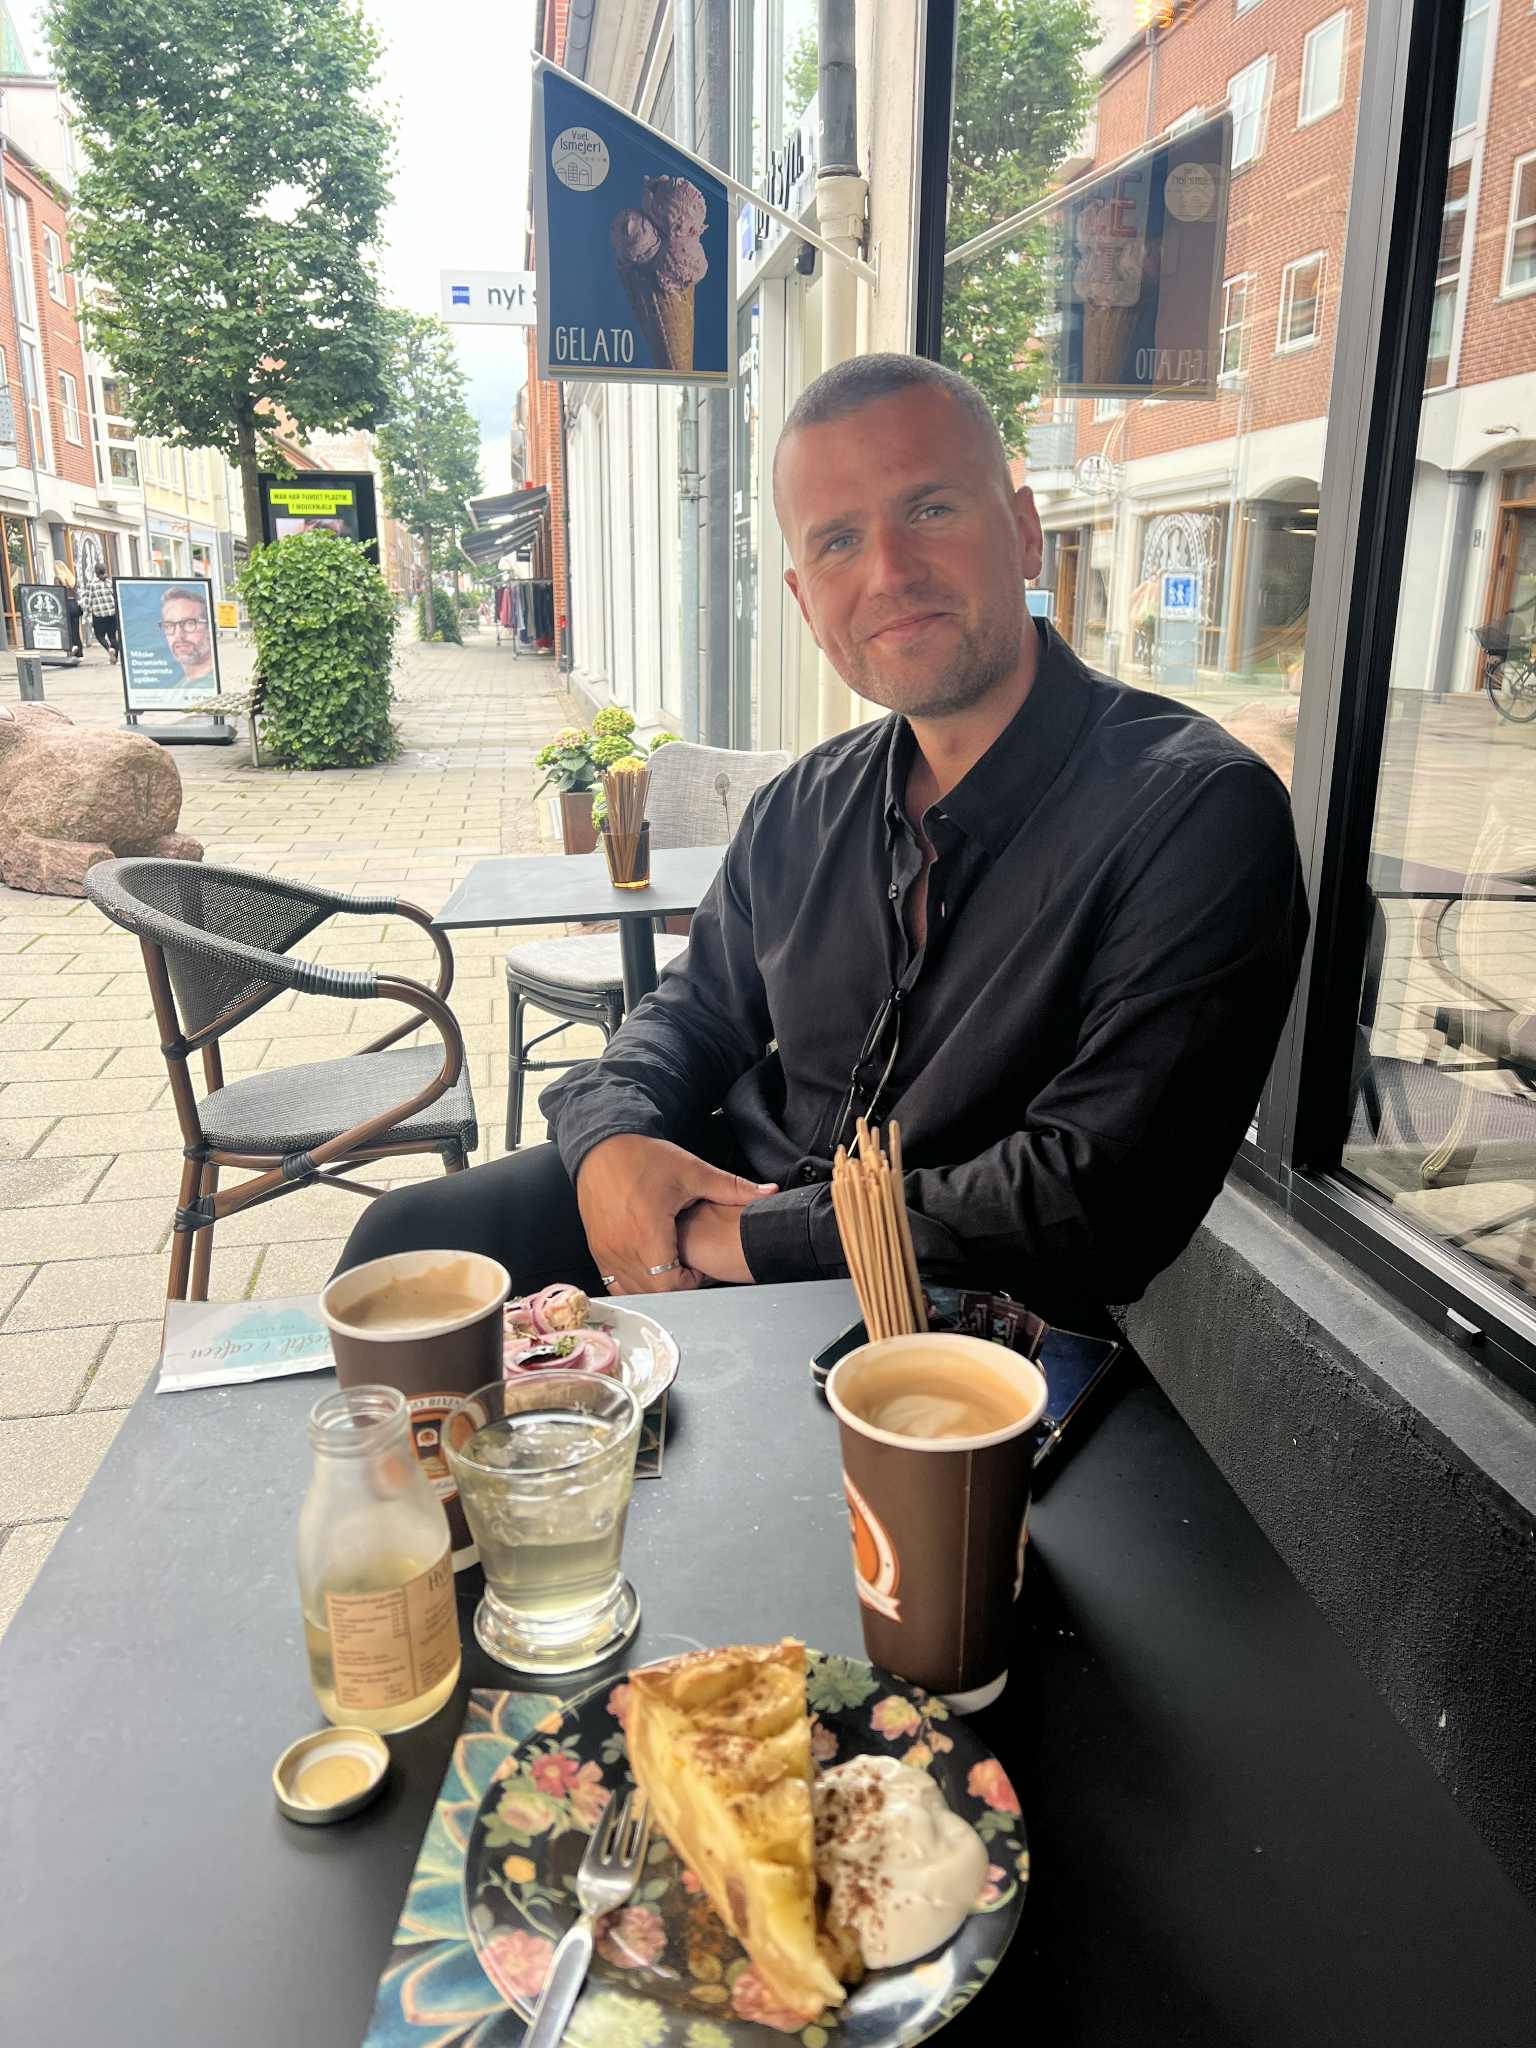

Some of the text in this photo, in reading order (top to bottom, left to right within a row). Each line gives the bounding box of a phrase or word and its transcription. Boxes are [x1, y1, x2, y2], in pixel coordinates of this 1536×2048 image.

[560, 137, 601, 154] Ismejeri
[487, 284, 526, 310] nyt
[555, 326, 635, 363] GELATO
[324, 493, 347, 501] PLASTIK
